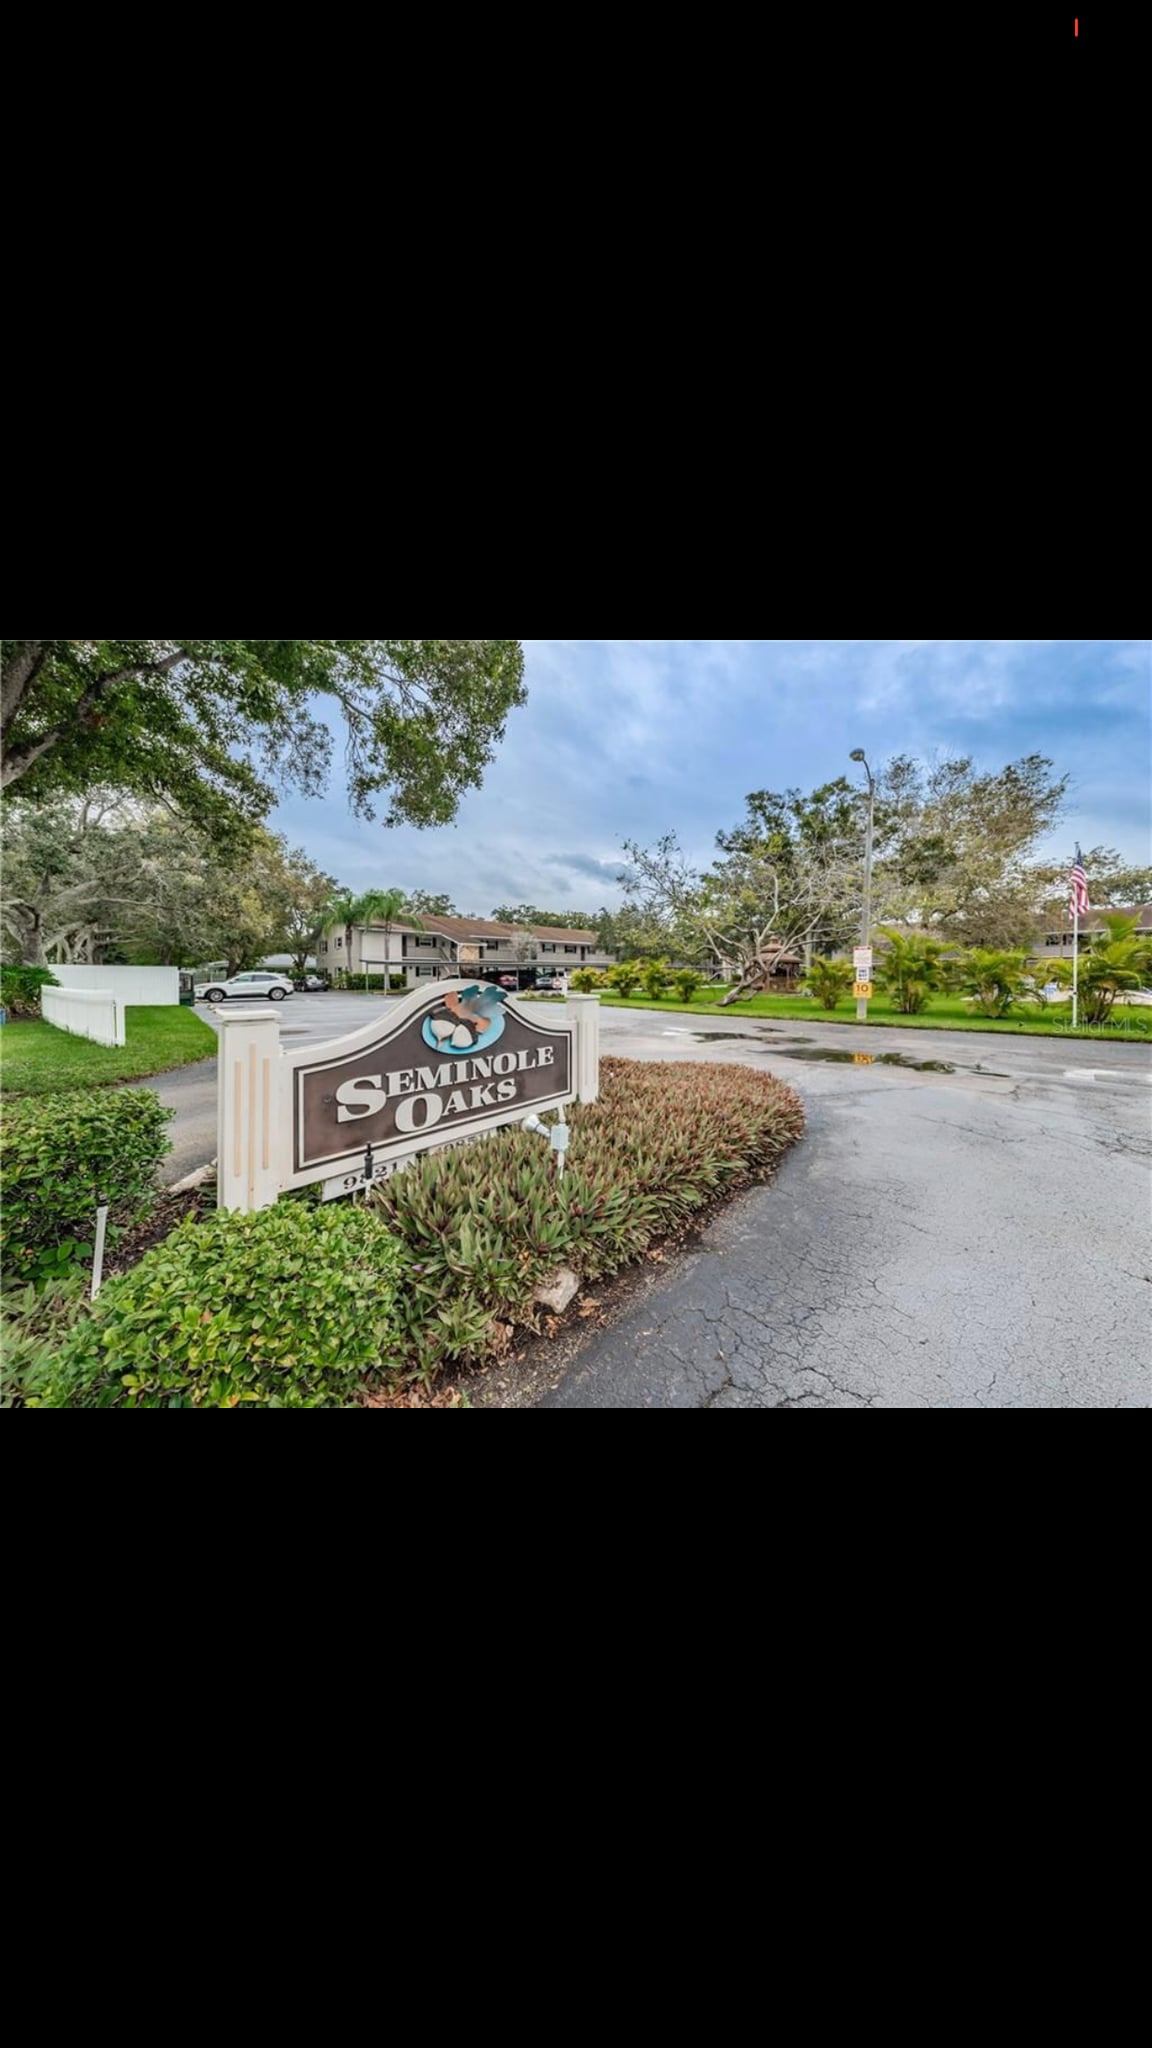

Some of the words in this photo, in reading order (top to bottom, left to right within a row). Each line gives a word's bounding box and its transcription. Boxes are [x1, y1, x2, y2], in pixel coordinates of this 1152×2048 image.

[856, 984, 869, 992] 10
[335, 1046, 554, 1123] SEMINOLE
[394, 1078, 517, 1133] OAKS
